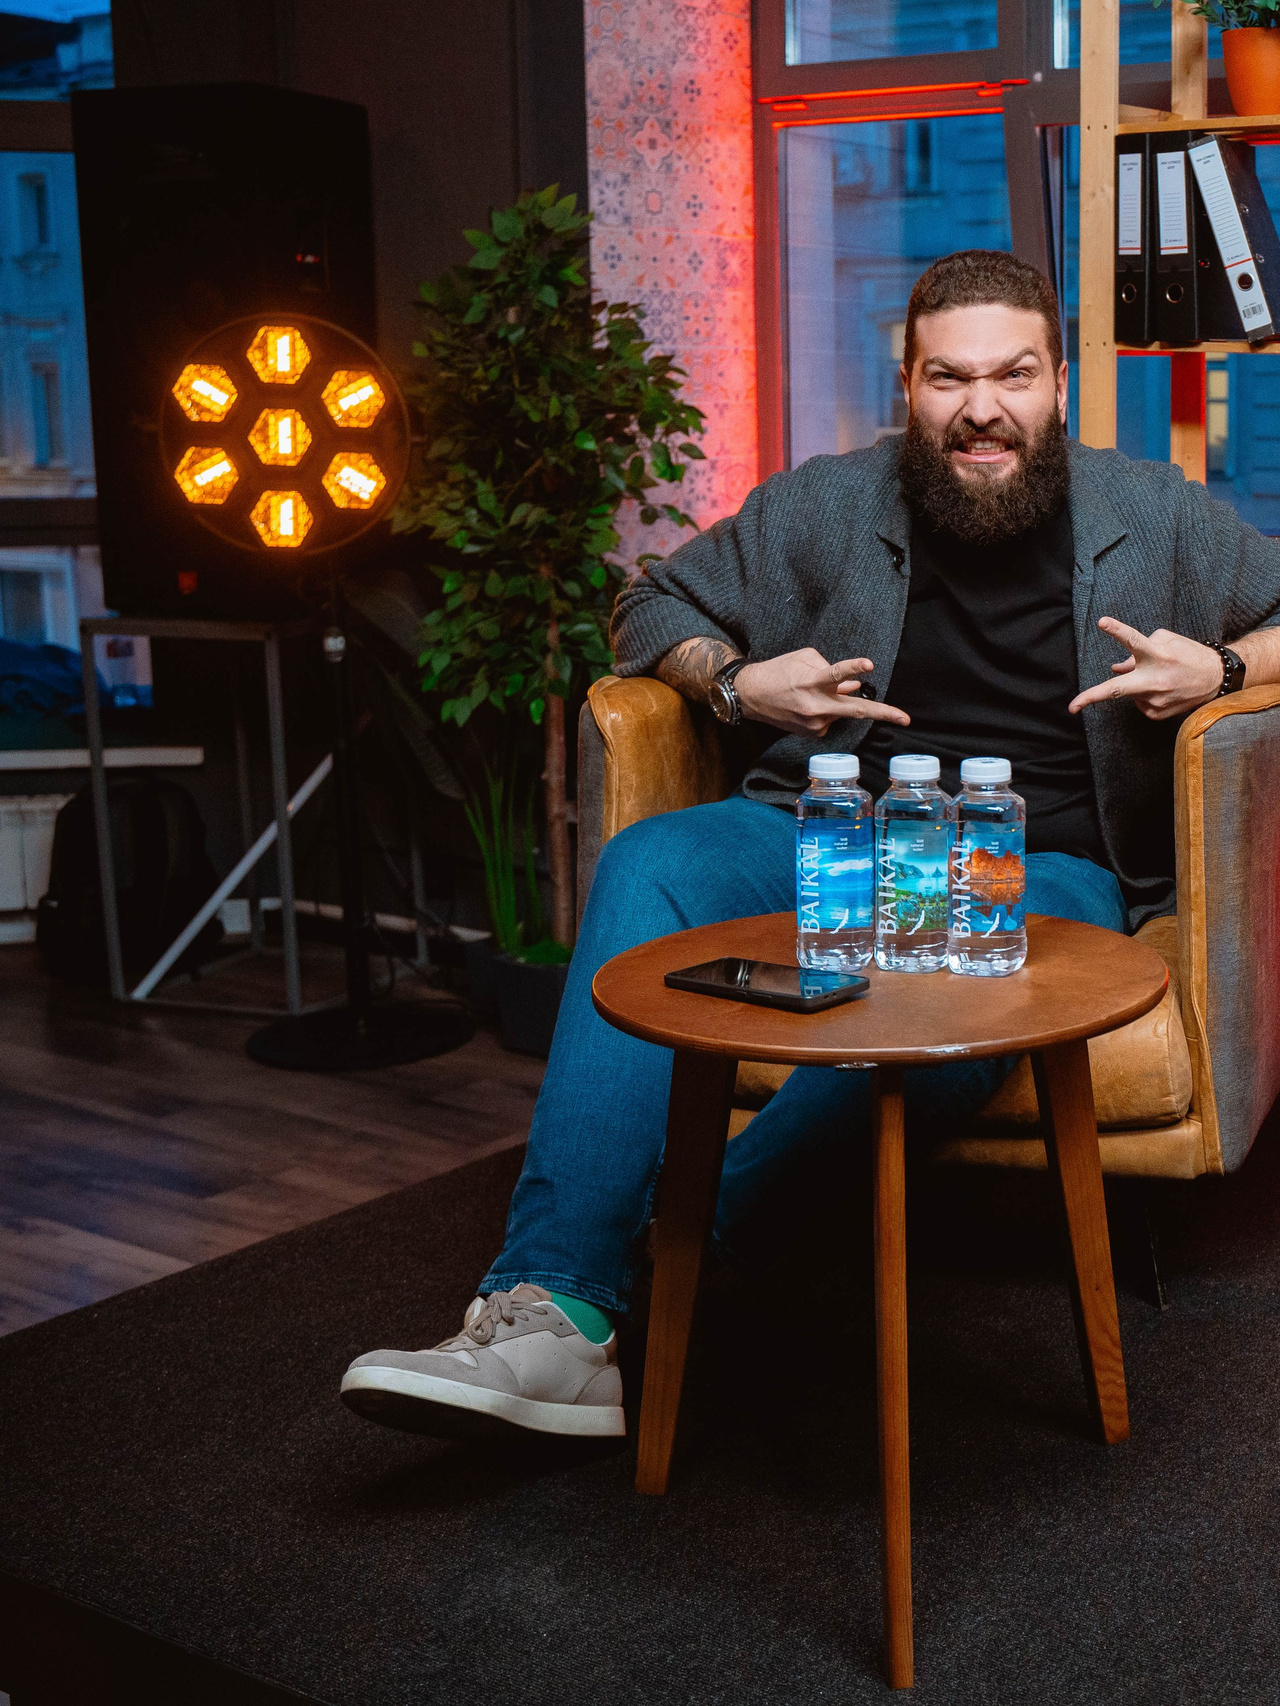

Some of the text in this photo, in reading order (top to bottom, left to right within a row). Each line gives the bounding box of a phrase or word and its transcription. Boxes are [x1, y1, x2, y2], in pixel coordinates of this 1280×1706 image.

[800, 836, 820, 934] BAIKAL
[878, 837, 897, 935] BAIKAL
[952, 839, 971, 938] BAIKAL
